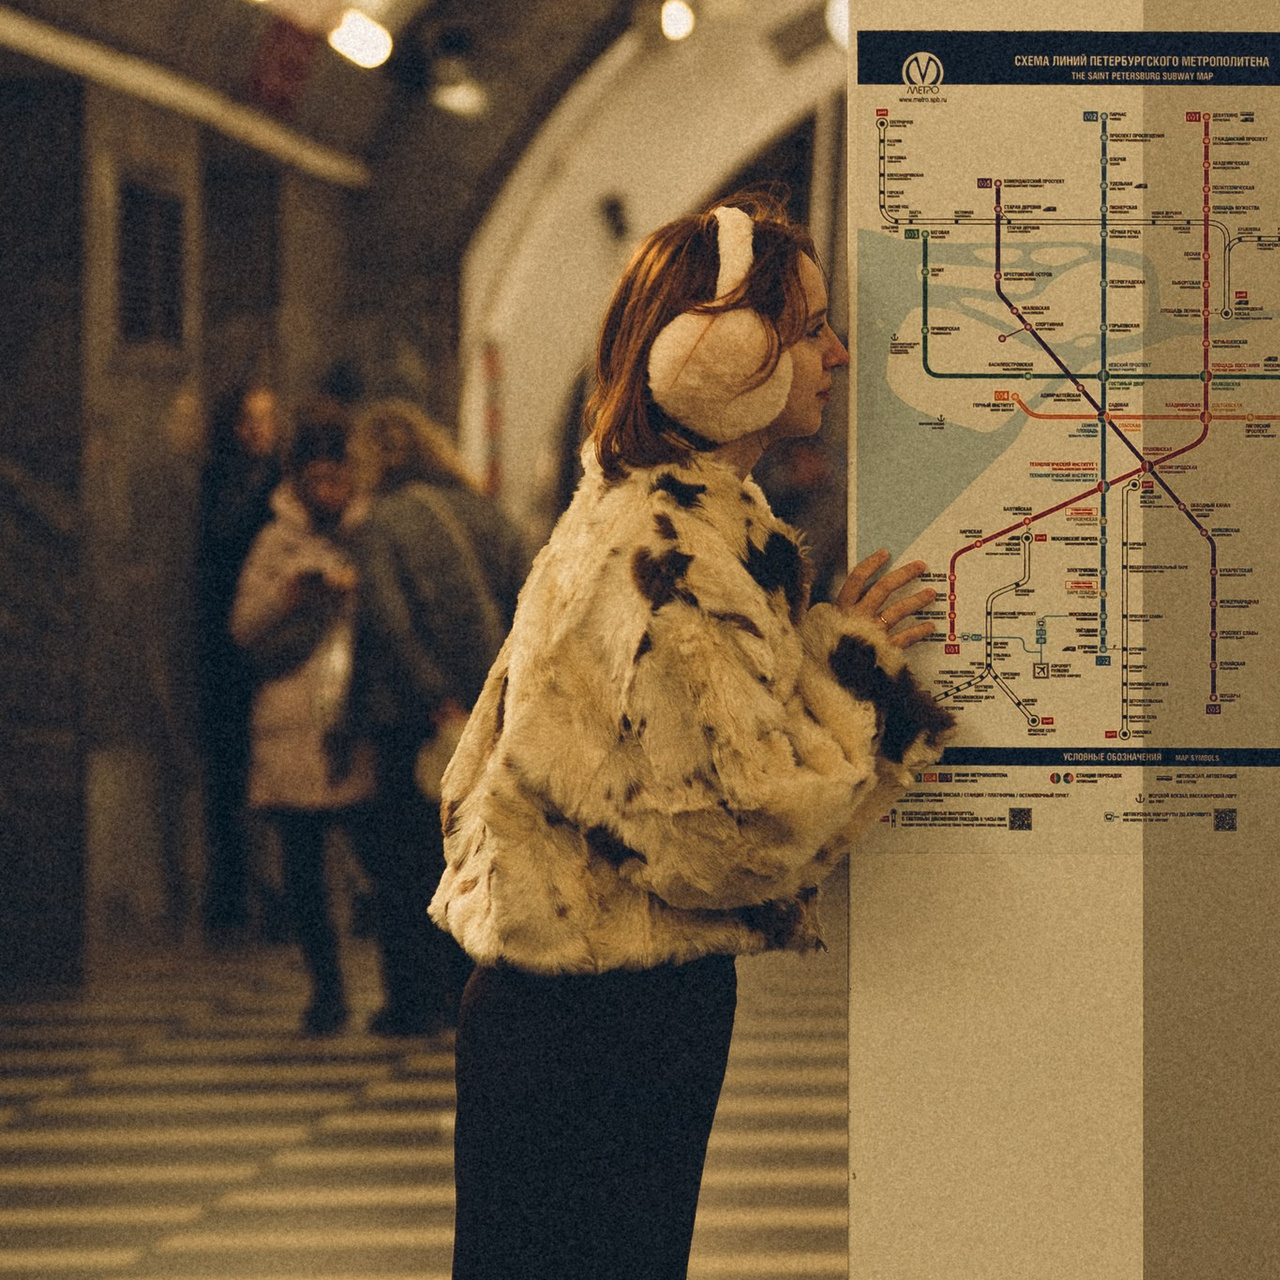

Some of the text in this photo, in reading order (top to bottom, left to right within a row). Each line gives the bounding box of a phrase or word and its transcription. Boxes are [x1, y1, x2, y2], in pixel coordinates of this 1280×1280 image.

[1014, 53, 1270, 67] СХЕМА ЛИНИЙ ПЕТЕРБУРГСКОГО МЕТРОПОЛИТЕНА
[1072, 72, 1214, 80] THE SAINT PETERSBURG SUBWAY MAP
[1063, 753, 1162, 761] УСЛОВНЫЕ ОБОЗНАЧЕНИЯ
